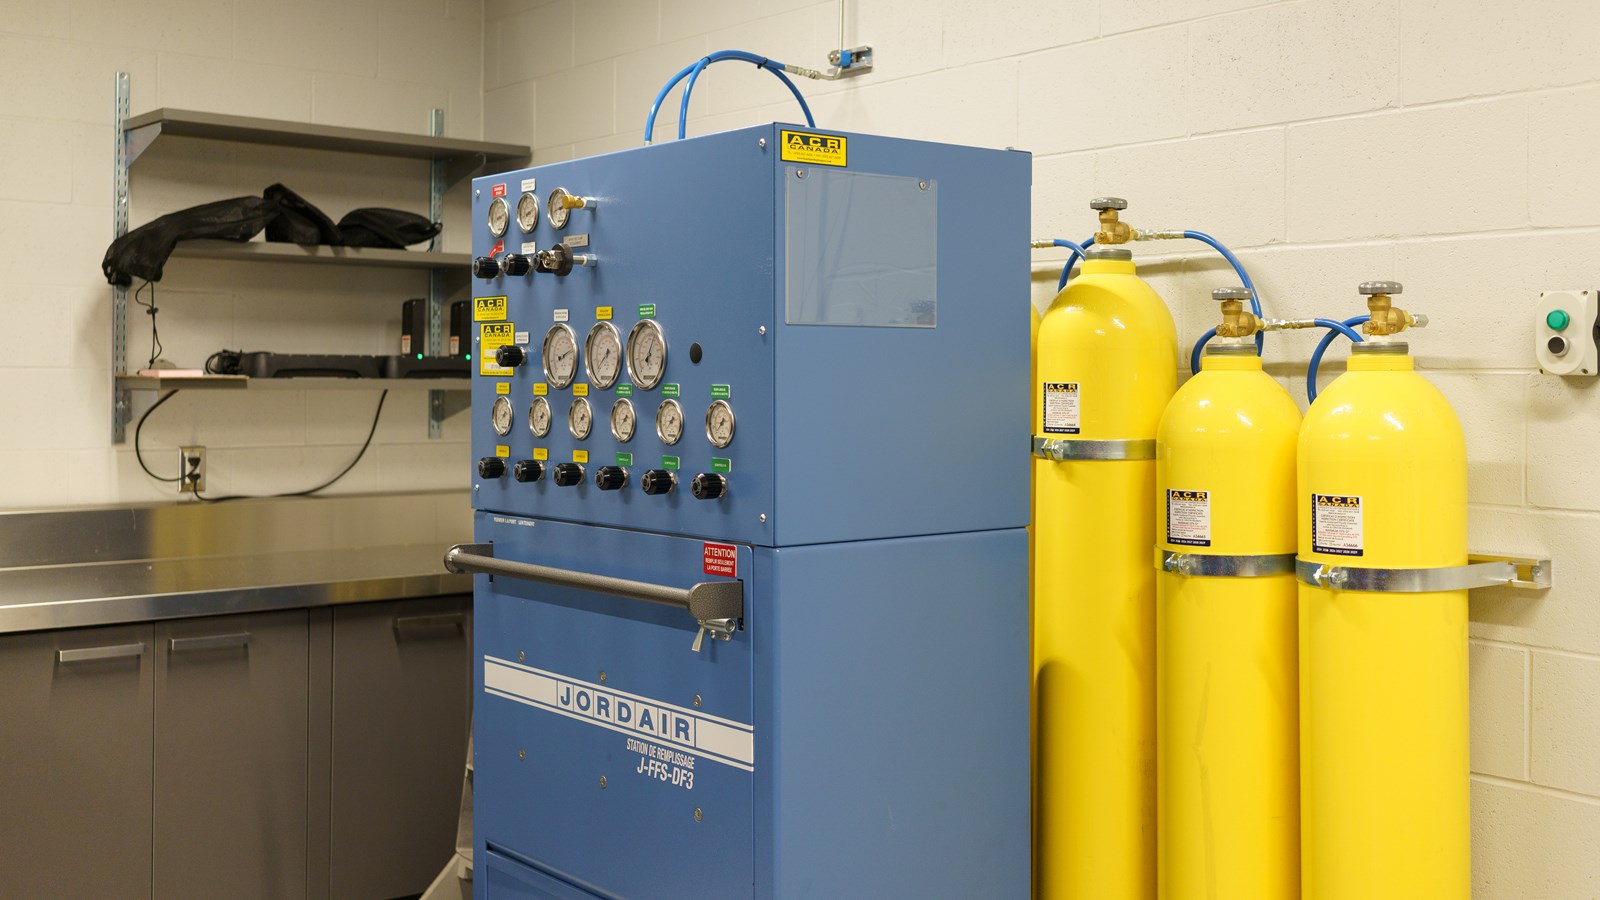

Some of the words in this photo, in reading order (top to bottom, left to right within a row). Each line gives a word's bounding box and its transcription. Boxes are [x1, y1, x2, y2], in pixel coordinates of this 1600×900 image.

[790, 135, 839, 149] ACR
[790, 144, 839, 154] CANADA
[478, 300, 503, 308] ACR
[1319, 496, 1358, 504] ACR
[704, 547, 736, 558] ATTENTION
[560, 687, 690, 741] JORDAIR
[626, 738, 649, 755] STATION
[649, 744, 657, 757] DE
[657, 747, 695, 770] REMPLISSAGE
[637, 757, 694, 790] J-FFS-DF3
